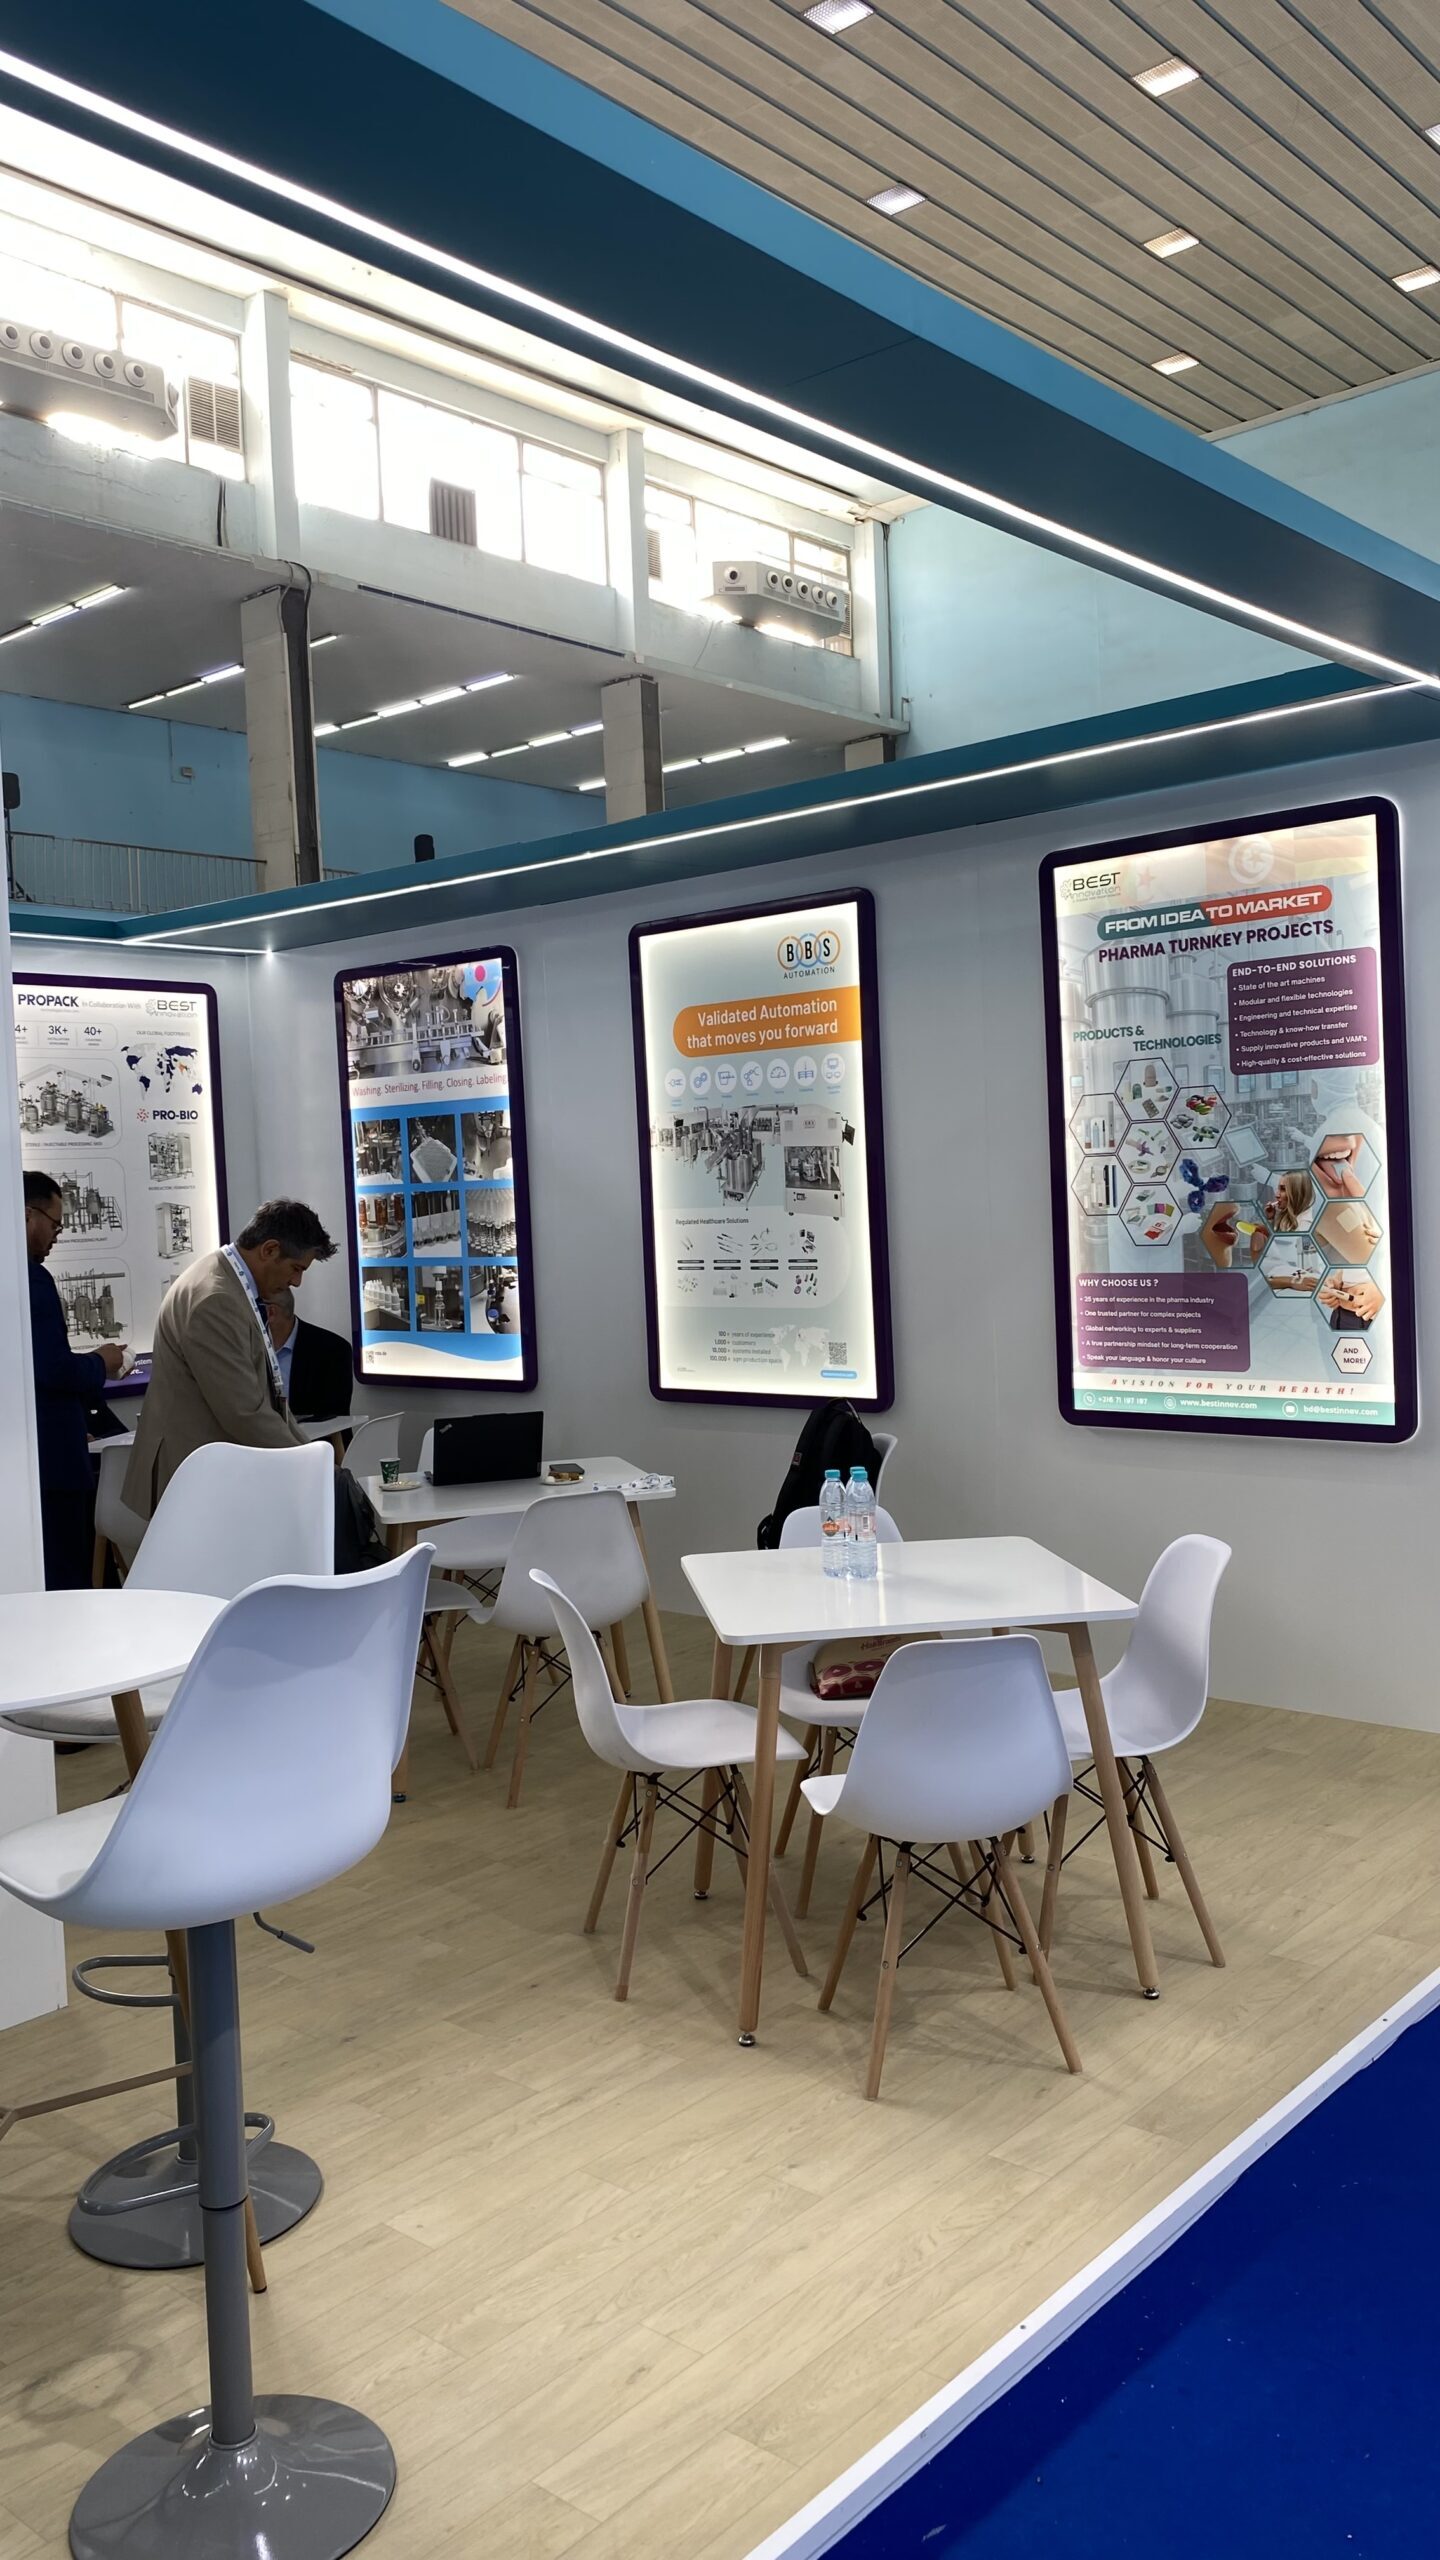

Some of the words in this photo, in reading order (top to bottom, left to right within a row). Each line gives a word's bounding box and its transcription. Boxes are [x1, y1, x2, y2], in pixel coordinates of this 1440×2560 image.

[1073, 872, 1120, 891] BEST
[1105, 915, 1158, 934] FROM
[1161, 909, 1205, 926] IDEA
[1206, 904, 1232, 919] TO
[1236, 892, 1322, 915] MARKET
[1099, 942, 1165, 963] PHARMA
[1168, 931, 1242, 954] TURNKEY
[1246, 919, 1333, 943] PROJECTS
[786, 937, 831, 962] BBS
[783, 966, 836, 979] AUTOMATION
[1232, 962, 1297, 977] END-TO-END
[1299, 955, 1357, 970] SOLUTIONS
[1238, 983, 1257, 992] State
[1258, 982, 1266, 990] of
[1280, 979, 1290, 987] art
[1291, 976, 1325, 986] machines
[18, 994, 79, 1007] PROPACK
[1238, 998, 1266, 1006] Modular
[1267, 996, 1280, 1004] and
[1281, 993, 1306, 1002] flexible
[1307, 988, 1353, 1000] technologies
[157, 1000, 197, 1011] BEST
[698, 1006, 757, 1027] Validated
[760, 998, 837, 1019] Automation
[1239, 1011, 1278, 1022] Engineering
[1279, 1010, 1291, 1018] and
[1292, 1006, 1324, 1016] technical
[1325, 1003, 1358, 1014] expertise
[15, 1024, 28, 1033] 4+
[48, 1025, 68, 1035] 3K+
[84, 1026, 102, 1036] 40+
[687, 1034, 712, 1049] that
[715, 1032, 756, 1046] moves
[759, 1028, 782, 1045] you
[785, 1019, 838, 1038] forward
[1073, 1026, 1133, 1042] PRODUCTS
[1135, 1025, 1144, 1036] &
[1240, 1027, 1278, 1038] Technology
[1285, 1025, 1320, 1034] know-how
[1321, 1021, 1349, 1030] transfer
[1133, 1033, 1222, 1051] TECHNOLOGIES
[1241, 1043, 1264, 1053] Supply
[1264, 1041, 1298, 1050] innovative
[1299, 1038, 1330, 1049] products
[1345, 1034, 1368, 1043] VAM's
[1241, 1056, 1280, 1068] High-quality
[1287, 1053, 1334, 1063] cost-effective
[1335, 1051, 1367, 1060] solutions
[153, 1110, 198, 1120] PRO-BIO
[1079, 1279, 1100, 1287] WHY
[1101, 1279, 1138, 1287] CHOOSE
[1140, 1279, 1152, 1287] US
[1153, 1279, 1159, 1287] ?
[1190, 1297, 1214, 1305] industry
[1105, 1325, 1136, 1334] networking
[1170, 1342, 1200, 1350] long-term
[1200, 1343, 1238, 1351] cooperation
[1119, 1355, 1146, 1363] language
[1185, 1381, 1213, 1389] FOR
[1225, 1383, 1266, 1391] YOUR
[1278, 1385, 1354, 1395] HEALTH!
